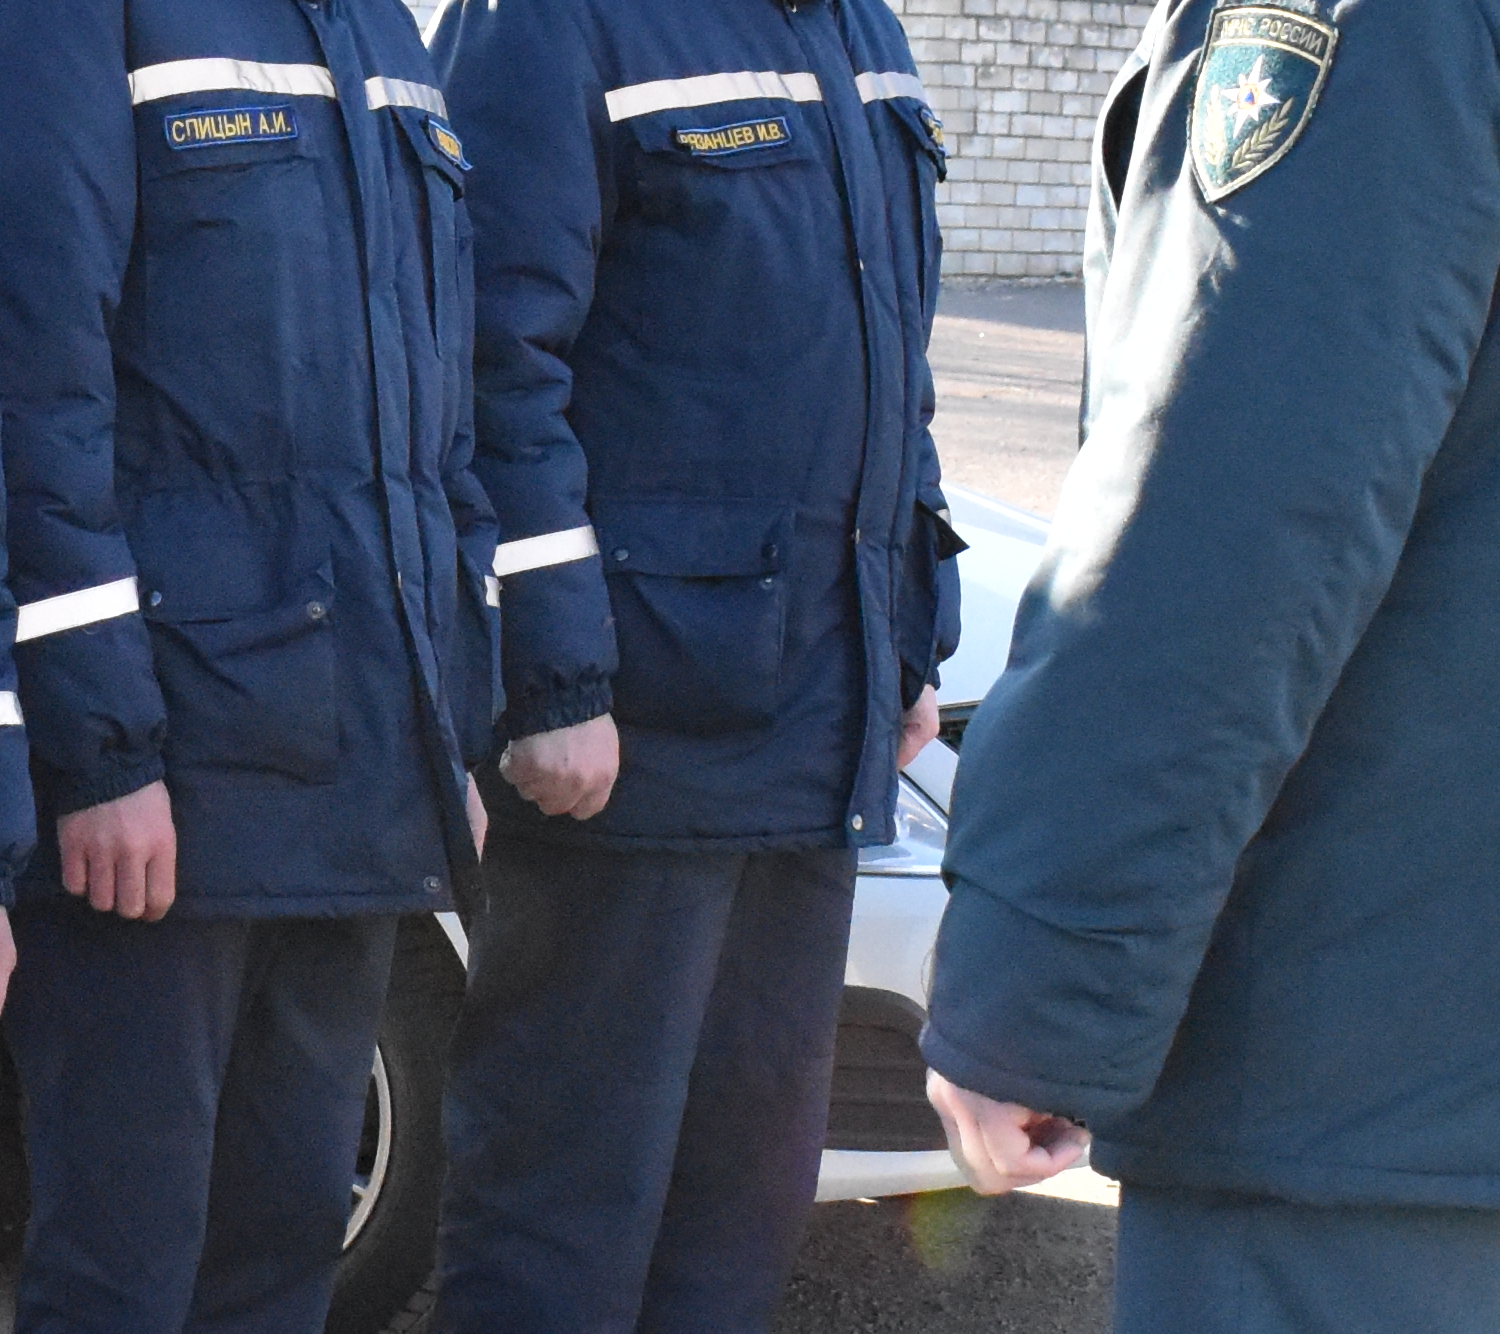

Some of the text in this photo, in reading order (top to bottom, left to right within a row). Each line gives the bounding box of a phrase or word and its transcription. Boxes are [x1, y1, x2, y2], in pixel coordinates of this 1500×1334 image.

[1258, 17, 1323, 55] РОССИИ
[172, 111, 292, 142] СПИЦЫН А.И.
[756, 123, 786, 142] И.В.
